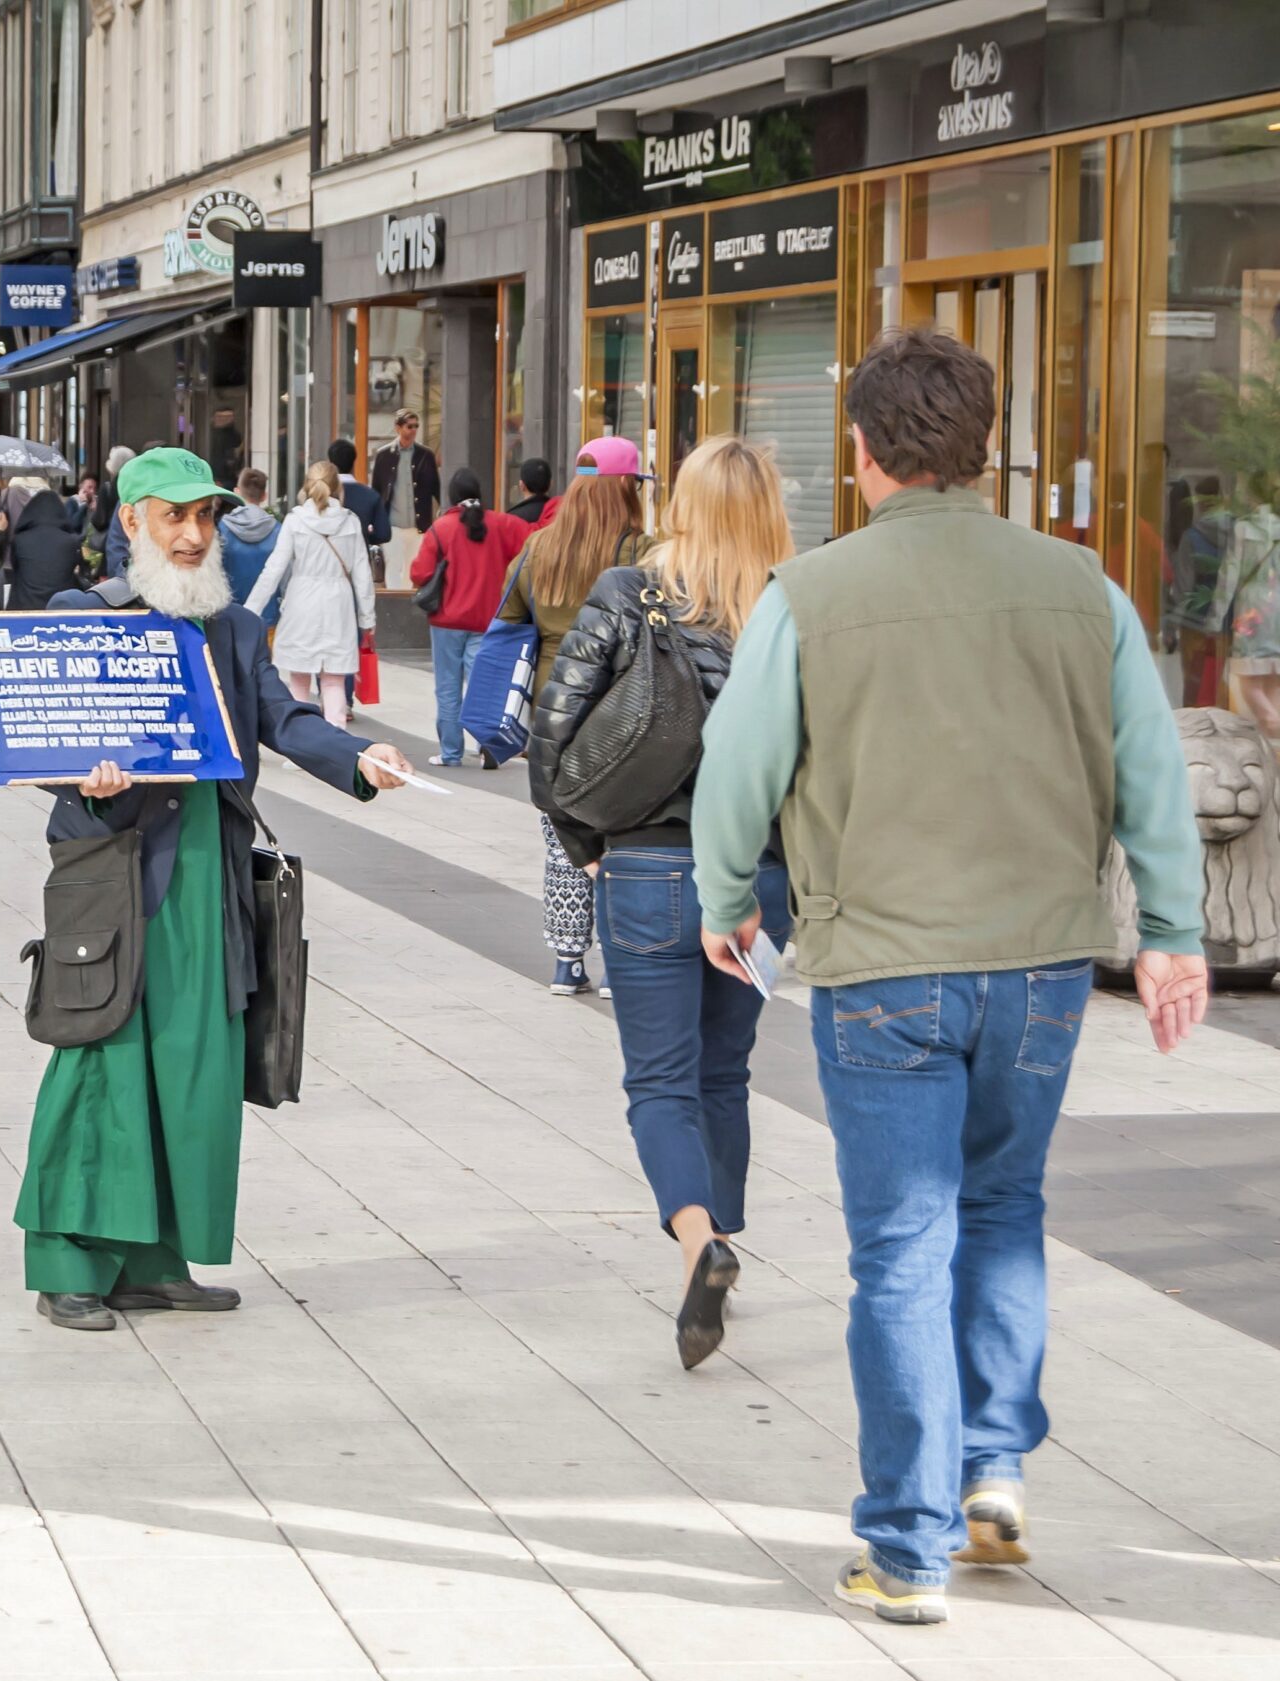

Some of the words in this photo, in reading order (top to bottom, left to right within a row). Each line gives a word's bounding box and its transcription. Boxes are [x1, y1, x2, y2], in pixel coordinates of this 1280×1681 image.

[643, 128, 715, 178] FRANKS
[189, 191, 263, 226] ESPRESSO
[376, 212, 436, 277] Jerns
[714, 233, 766, 261] BREITLING
[198, 248, 234, 269] HOU
[240, 261, 305, 277] Jerns
[6, 284, 67, 296] WAYNE'S
[9, 296, 63, 309] COFFEE
[66, 657, 101, 679] AND
[69, 697, 82, 707] TO
[82, 697, 94, 707] BE
[2, 724, 16, 735] TO
[81, 723, 105, 734] PEACE
[127, 723, 145, 733] AND
[177, 723, 195, 733] THE
[48, 737, 60, 748] OF
[61, 736, 79, 747] THE
[79, 736, 100, 747] HOLY
